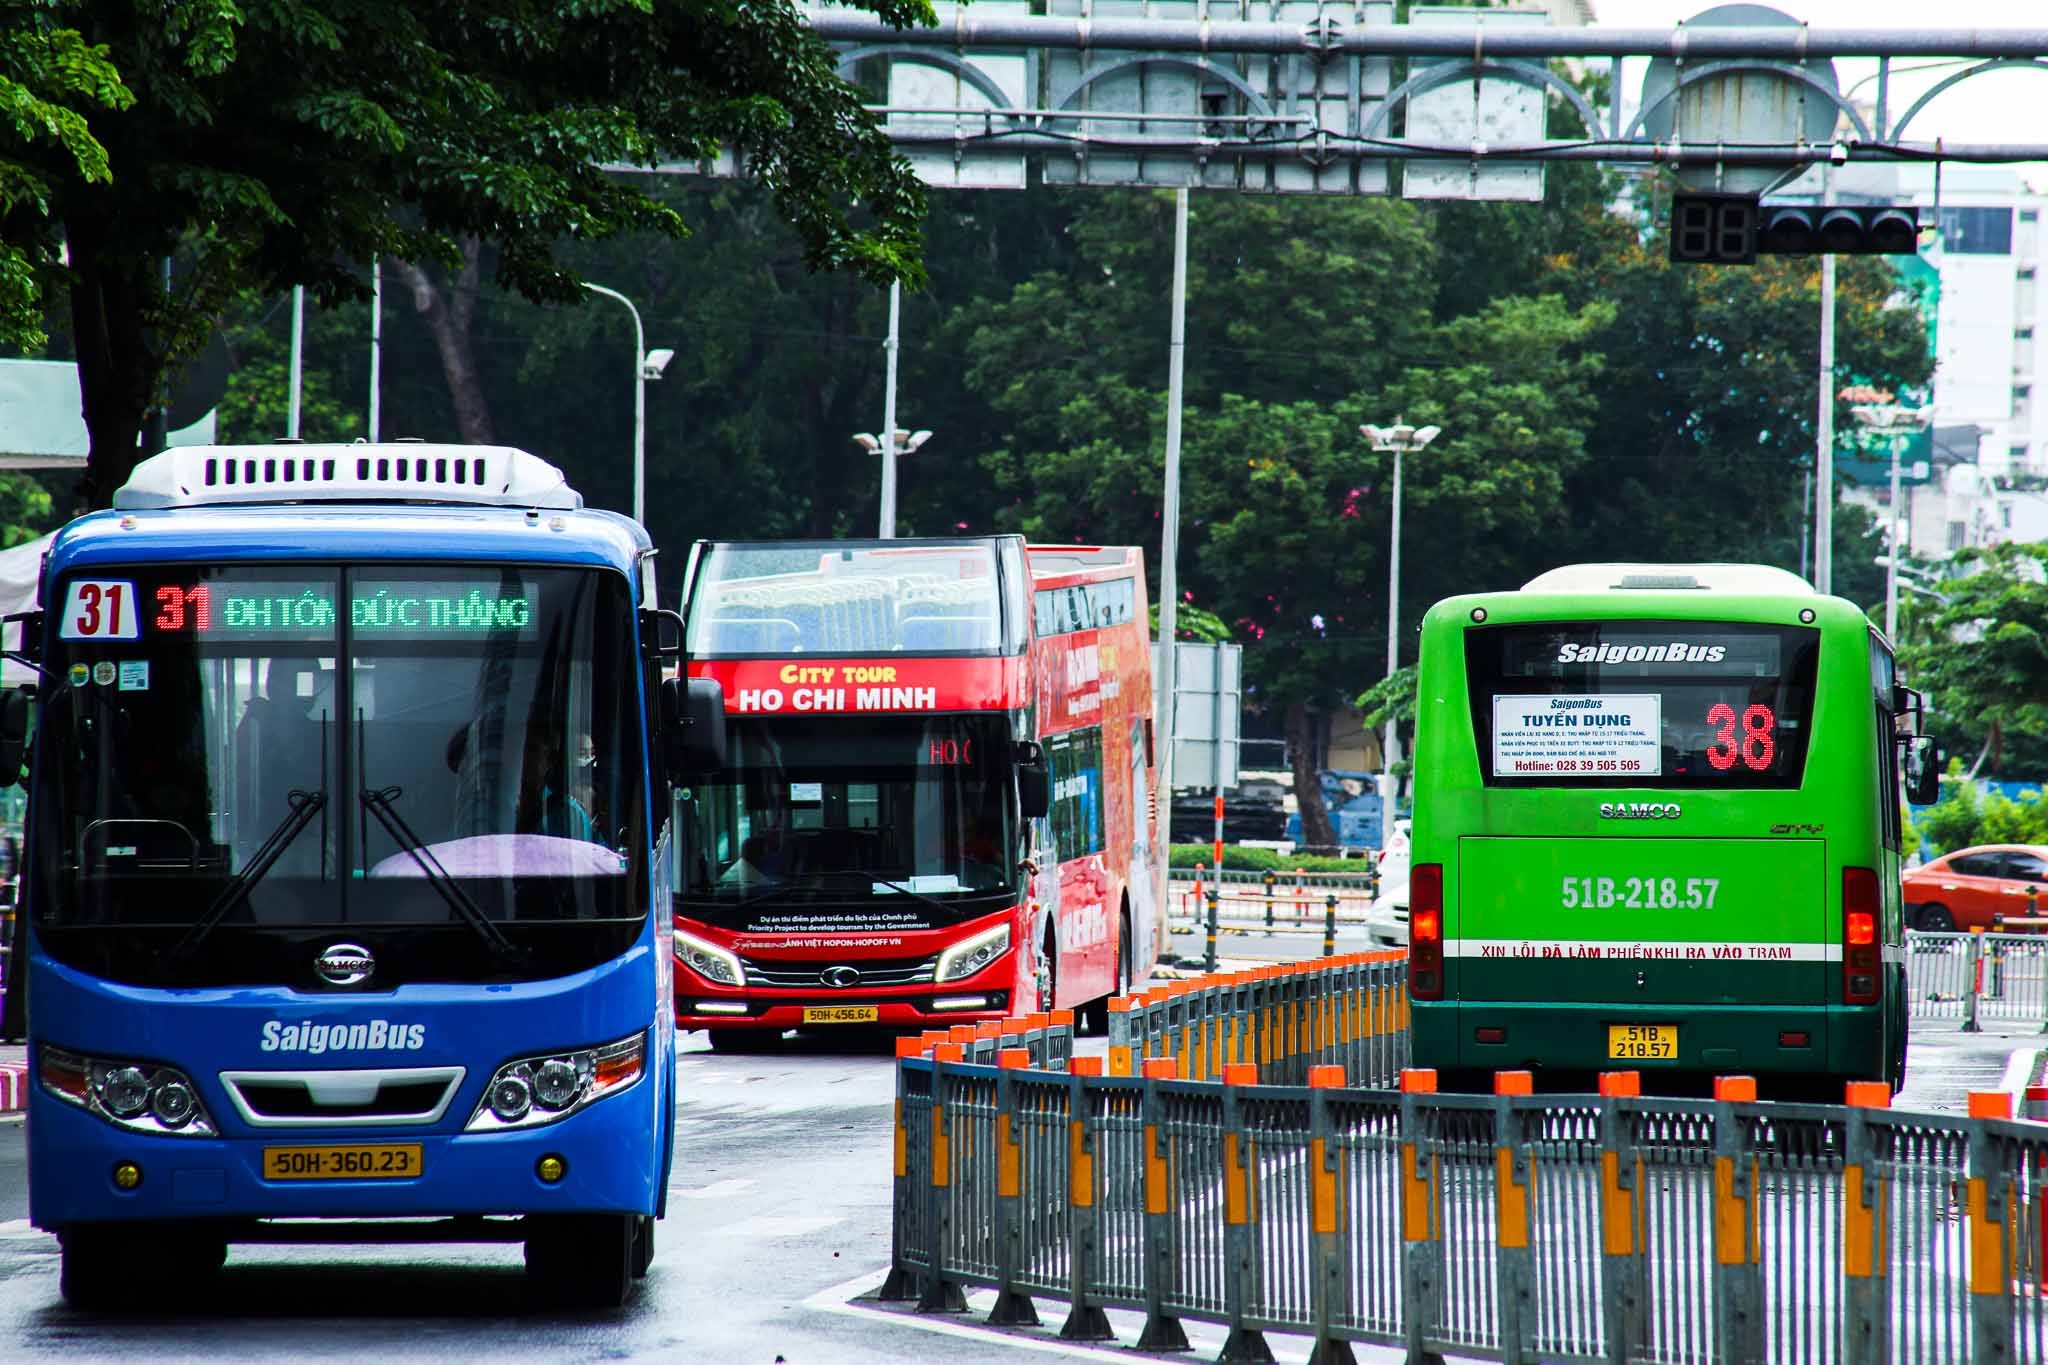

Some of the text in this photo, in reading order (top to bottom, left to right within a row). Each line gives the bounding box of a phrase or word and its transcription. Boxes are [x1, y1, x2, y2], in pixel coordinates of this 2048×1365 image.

[77, 583, 122, 636] 31
[156, 587, 209, 629] 31
[1558, 643, 1726, 665] SaigonBus
[843, 666, 897, 683] TOUR
[739, 687, 936, 712] HO CHI MINH
[1550, 699, 1603, 710] SaigonBus
[1583, 714, 1631, 729] DỤNG
[1706, 703, 1774, 770] 38
[931, 738, 958, 765] HO
[1515, 760, 1640, 771] Hotline: 028 39 505 505
[1600, 803, 1681, 819] SAMCO
[1562, 876, 1720, 909] 51B-218.57
[748, 924, 773, 932] Priority
[774, 924, 799, 932] Project
[808, 924, 836, 932] develop
[886, 922, 930, 930] Government
[1481, 945, 1505, 958] XIN
[1542, 944, 1562, 958] ĐÃ
[1569, 944, 1601, 958] LÀM
[1686, 947, 1706, 958] RA
[1712, 944, 1742, 959] VÀO
[261, 1020, 425, 1054] SaigonBus
[1628, 1027, 1658, 1041] 51B
[1616, 1043, 1671, 1057] 218.57
[277, 1151, 409, 1173] 50H-360.23
